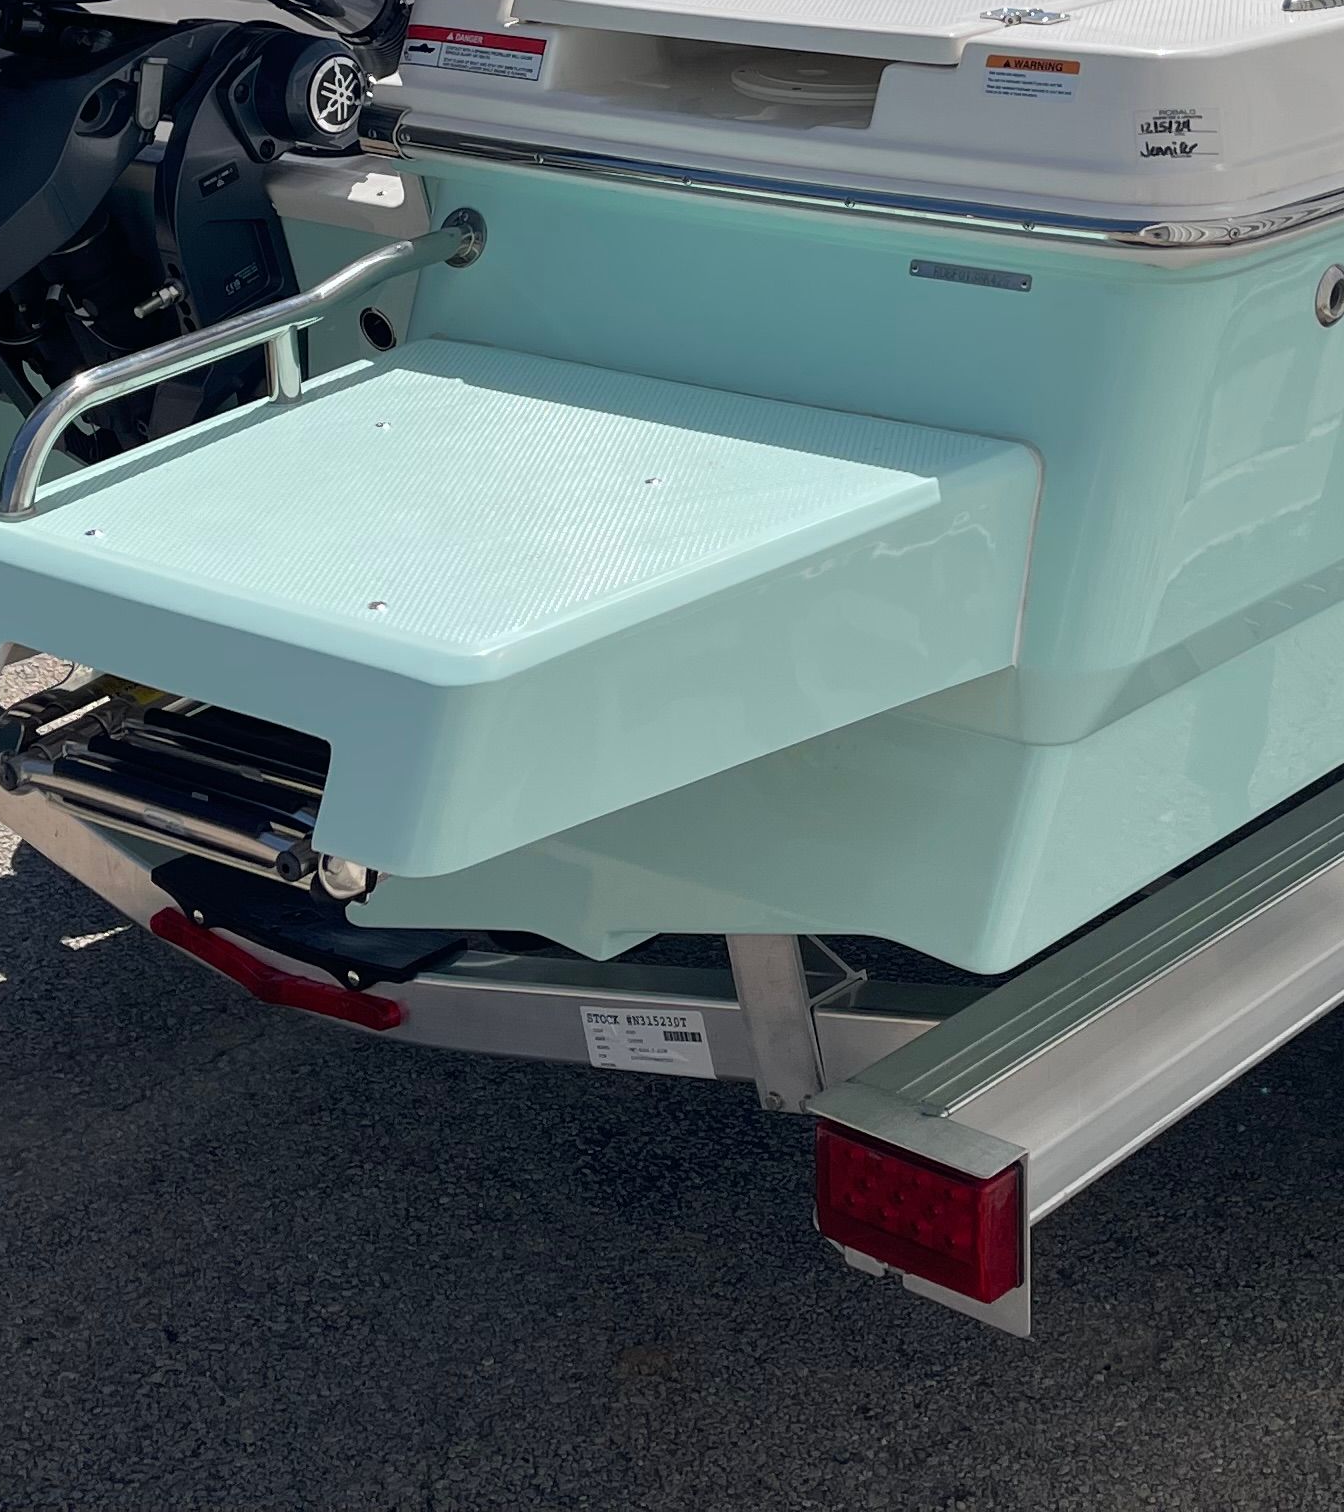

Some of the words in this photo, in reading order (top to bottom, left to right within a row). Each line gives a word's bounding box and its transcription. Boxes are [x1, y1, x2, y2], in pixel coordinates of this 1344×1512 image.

[455, 32, 484, 44] DANGER
[1015, 60, 1064, 72] WARNING
[586, 1013, 620, 1025] STOCK
